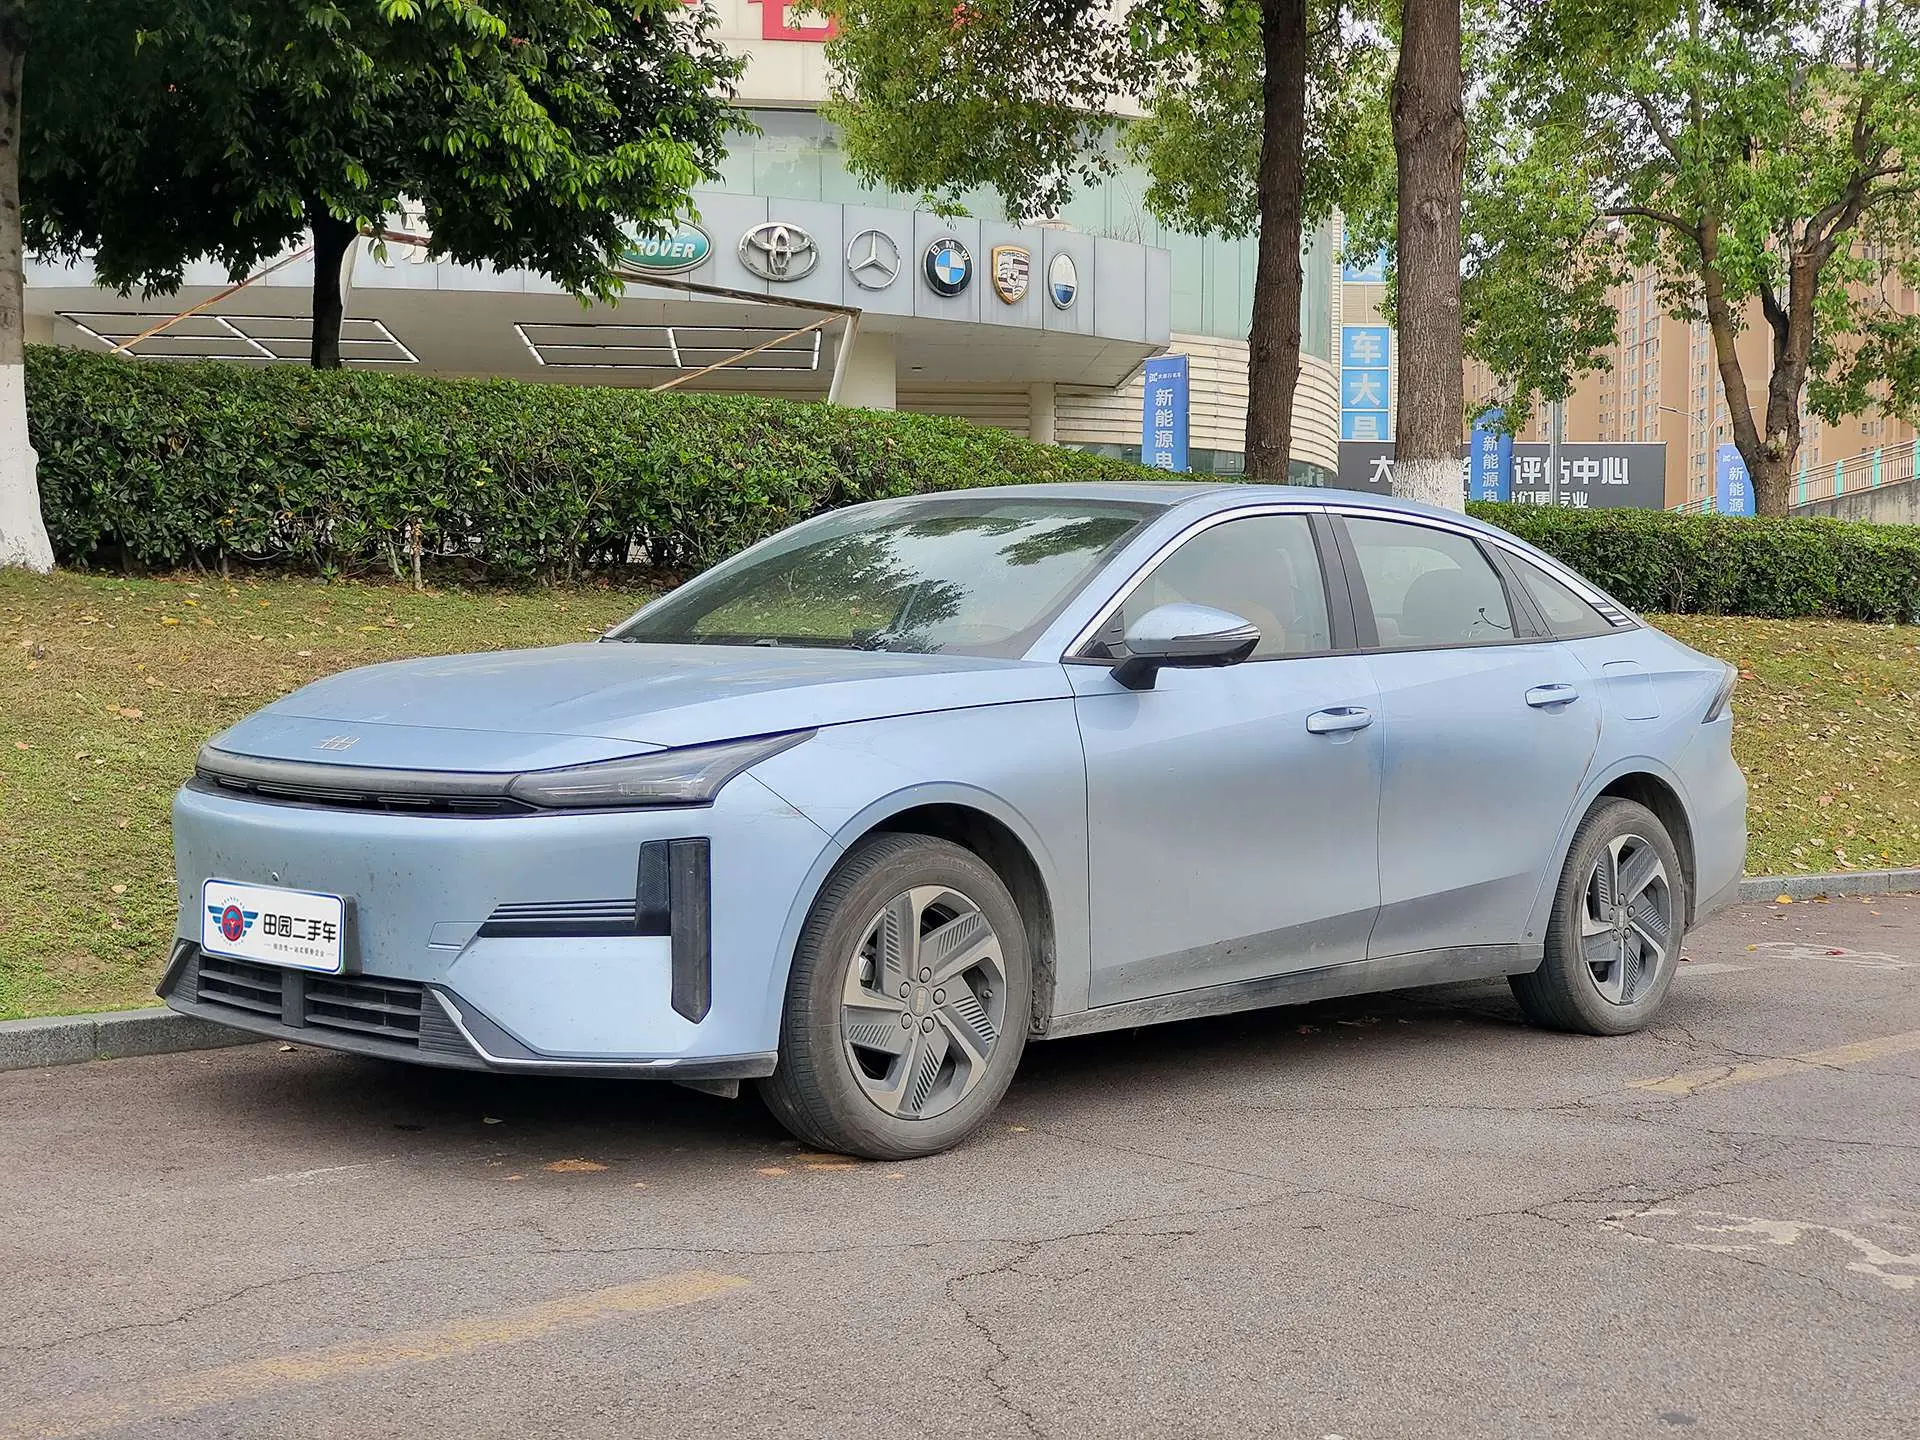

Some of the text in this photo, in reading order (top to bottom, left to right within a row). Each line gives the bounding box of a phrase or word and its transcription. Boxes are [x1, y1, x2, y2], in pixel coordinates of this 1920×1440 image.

[631, 241, 696, 258] ROVER
[930, 240, 970, 262] BMW
[1155, 388, 1174, 470] 新能源电
[1728, 466, 1744, 513] 新能源
[263, 913, 336, 943] 田园二手车
